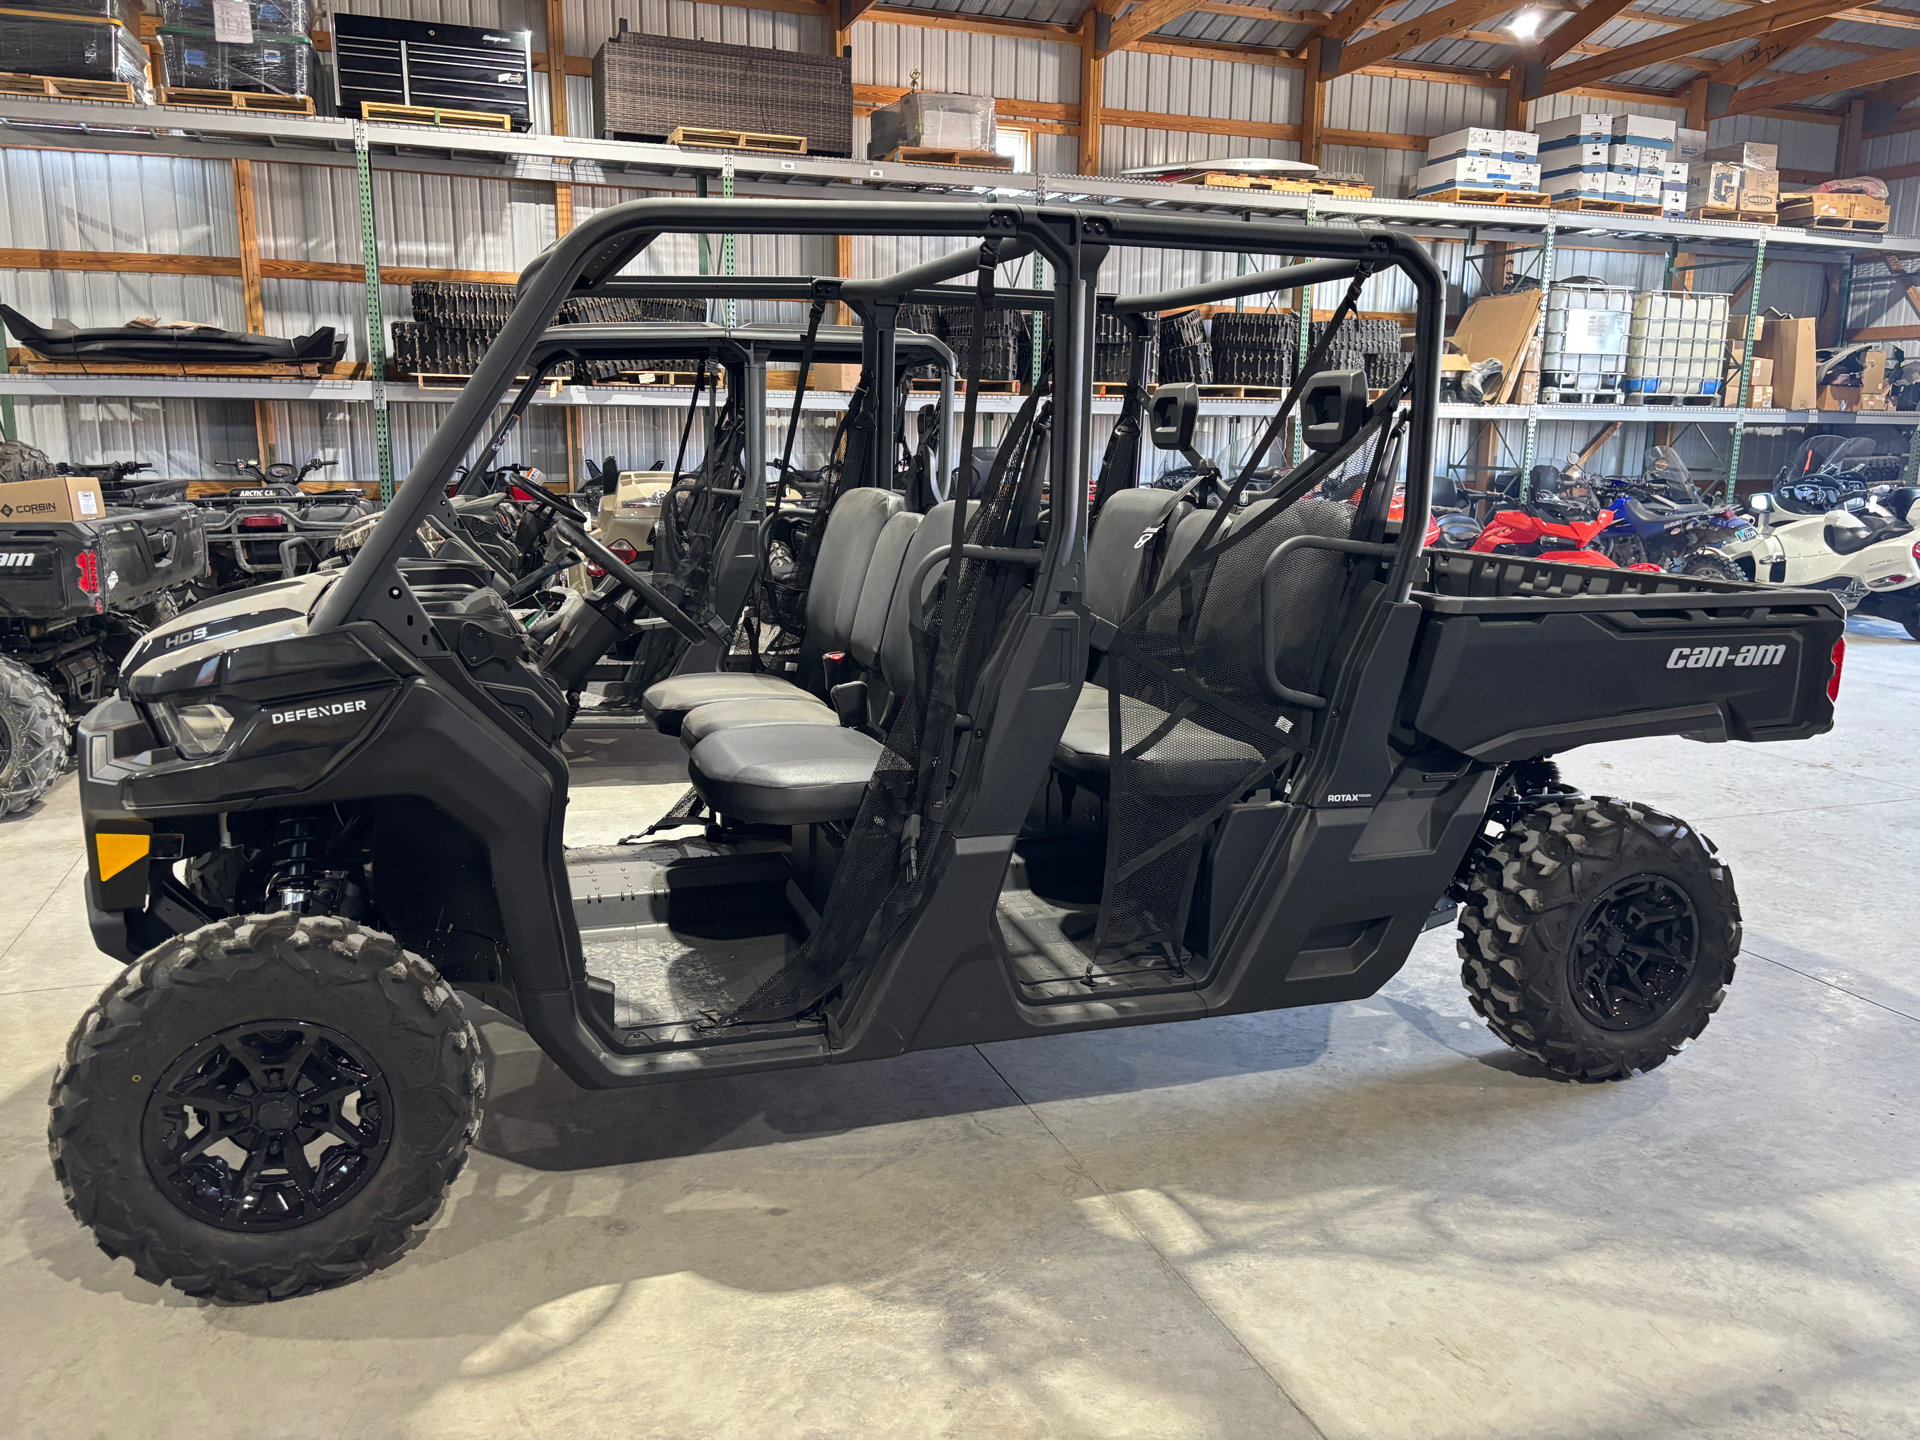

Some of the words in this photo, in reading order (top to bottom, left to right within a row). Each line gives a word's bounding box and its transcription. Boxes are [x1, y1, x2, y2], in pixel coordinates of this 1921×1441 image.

[16, 502, 56, 514] CORBIN
[1665, 644, 1787, 669] can-am
[271, 699, 367, 725] DEFENDER
[1327, 794, 1359, 802] ROTAX
